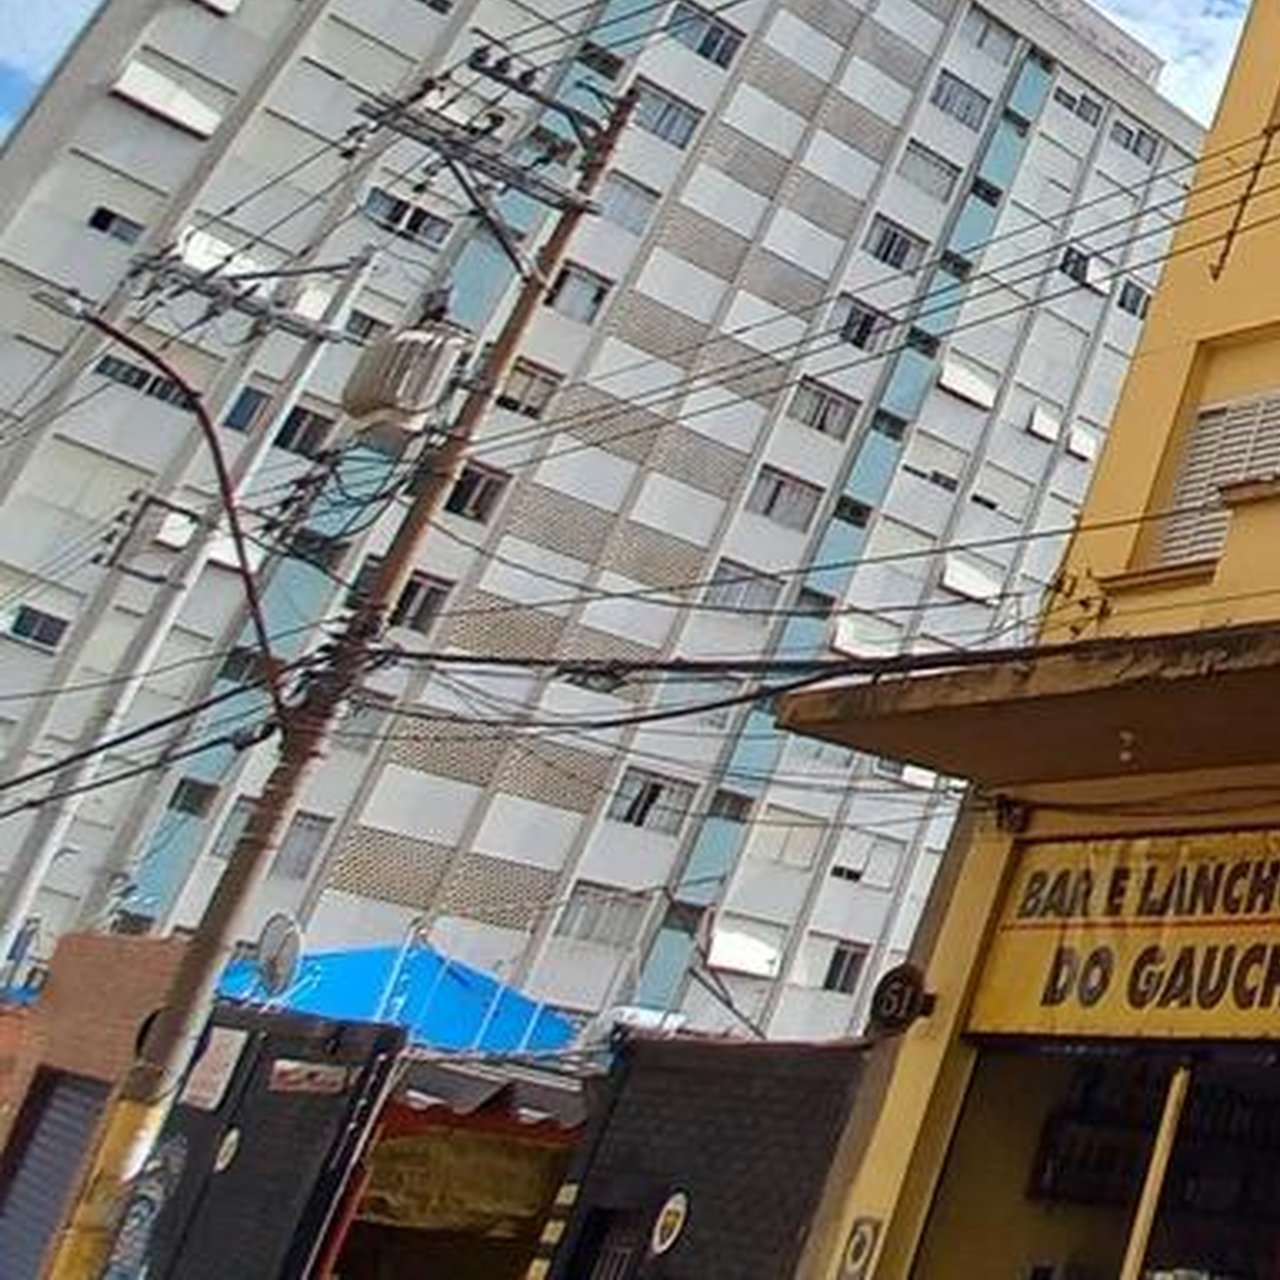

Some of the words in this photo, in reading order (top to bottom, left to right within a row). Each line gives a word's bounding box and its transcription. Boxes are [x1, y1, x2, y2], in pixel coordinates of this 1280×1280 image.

[1017, 866, 1093, 919] BAR
[1107, 866, 1131, 907] E
[1040, 944, 1115, 1009] DO
